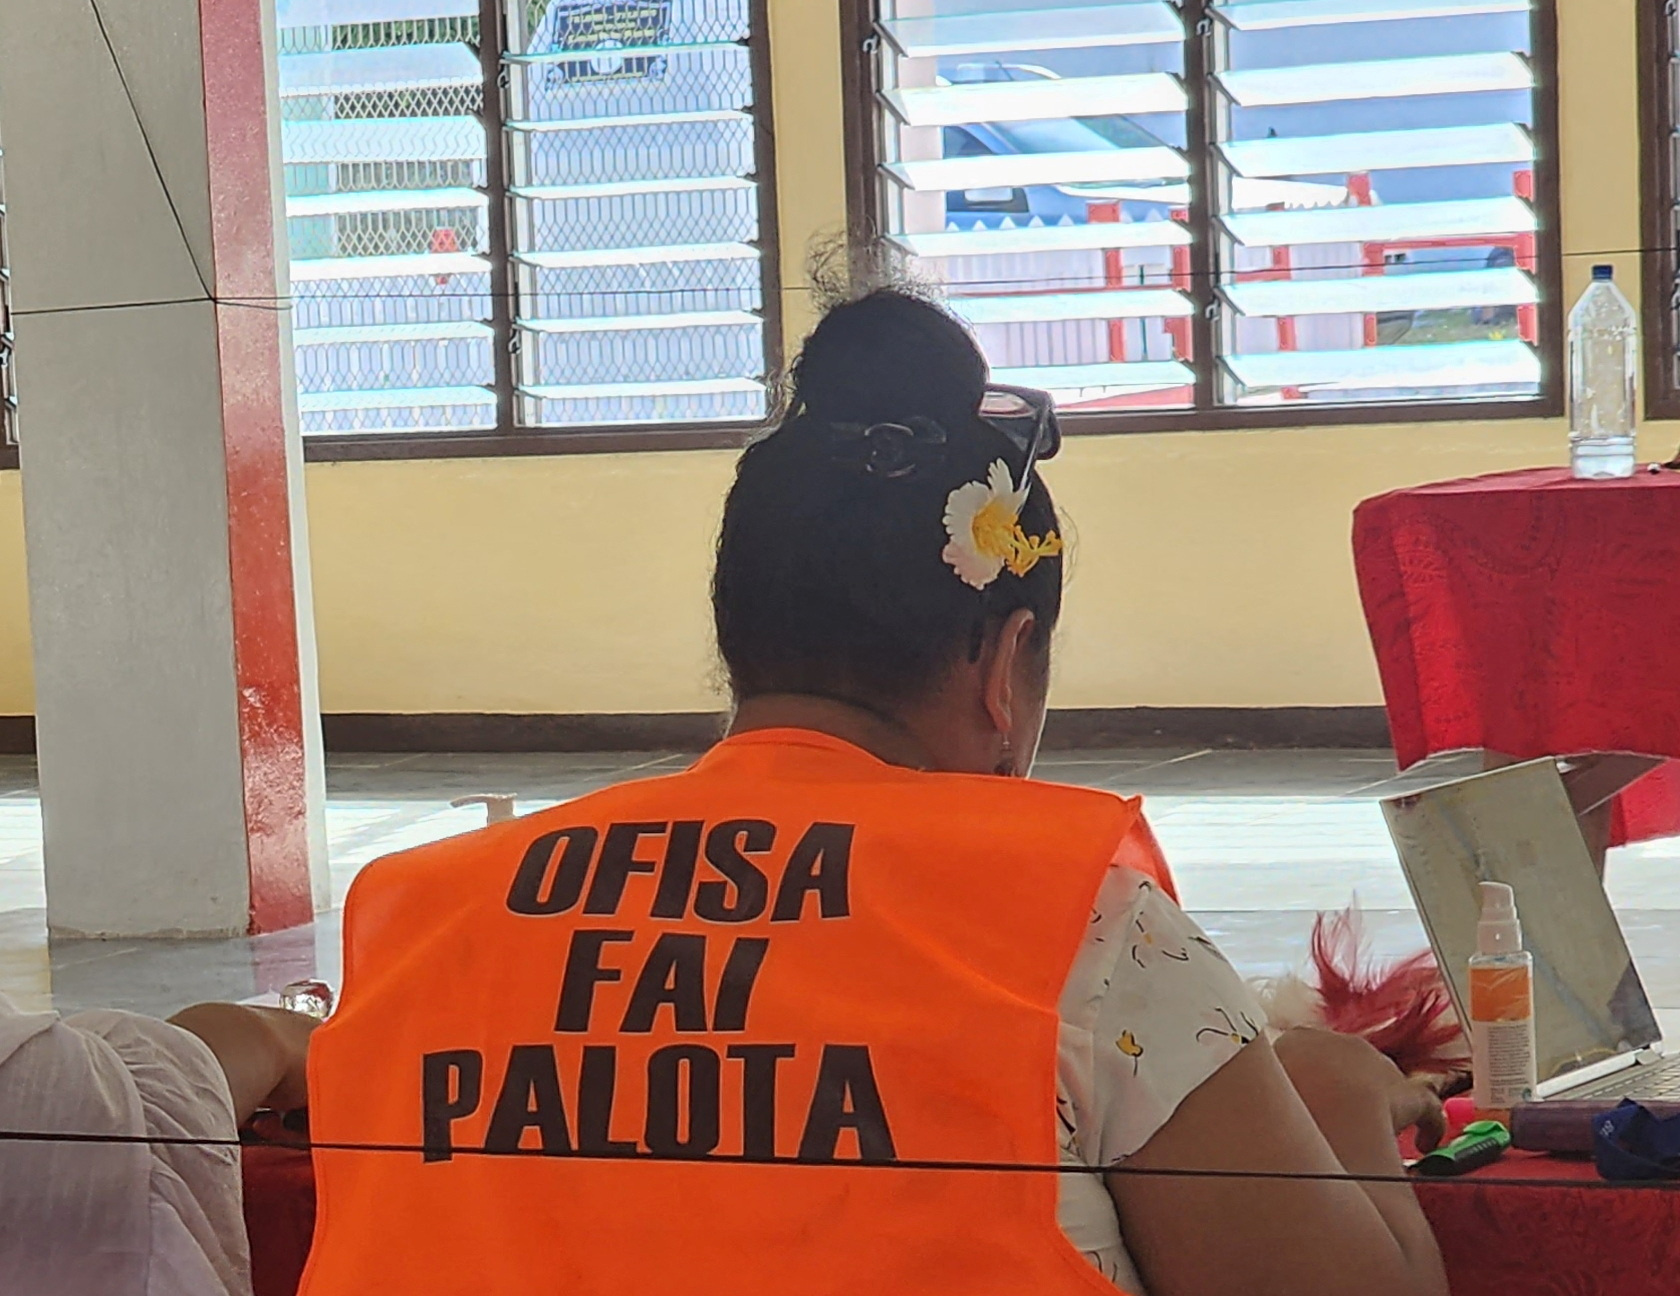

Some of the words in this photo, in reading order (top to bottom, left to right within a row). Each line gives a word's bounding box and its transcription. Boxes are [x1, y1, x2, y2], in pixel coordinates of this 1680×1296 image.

[506, 818, 855, 923] OFISA
[553, 928, 770, 1034] FAI
[422, 1043, 898, 1164] PALOTA
